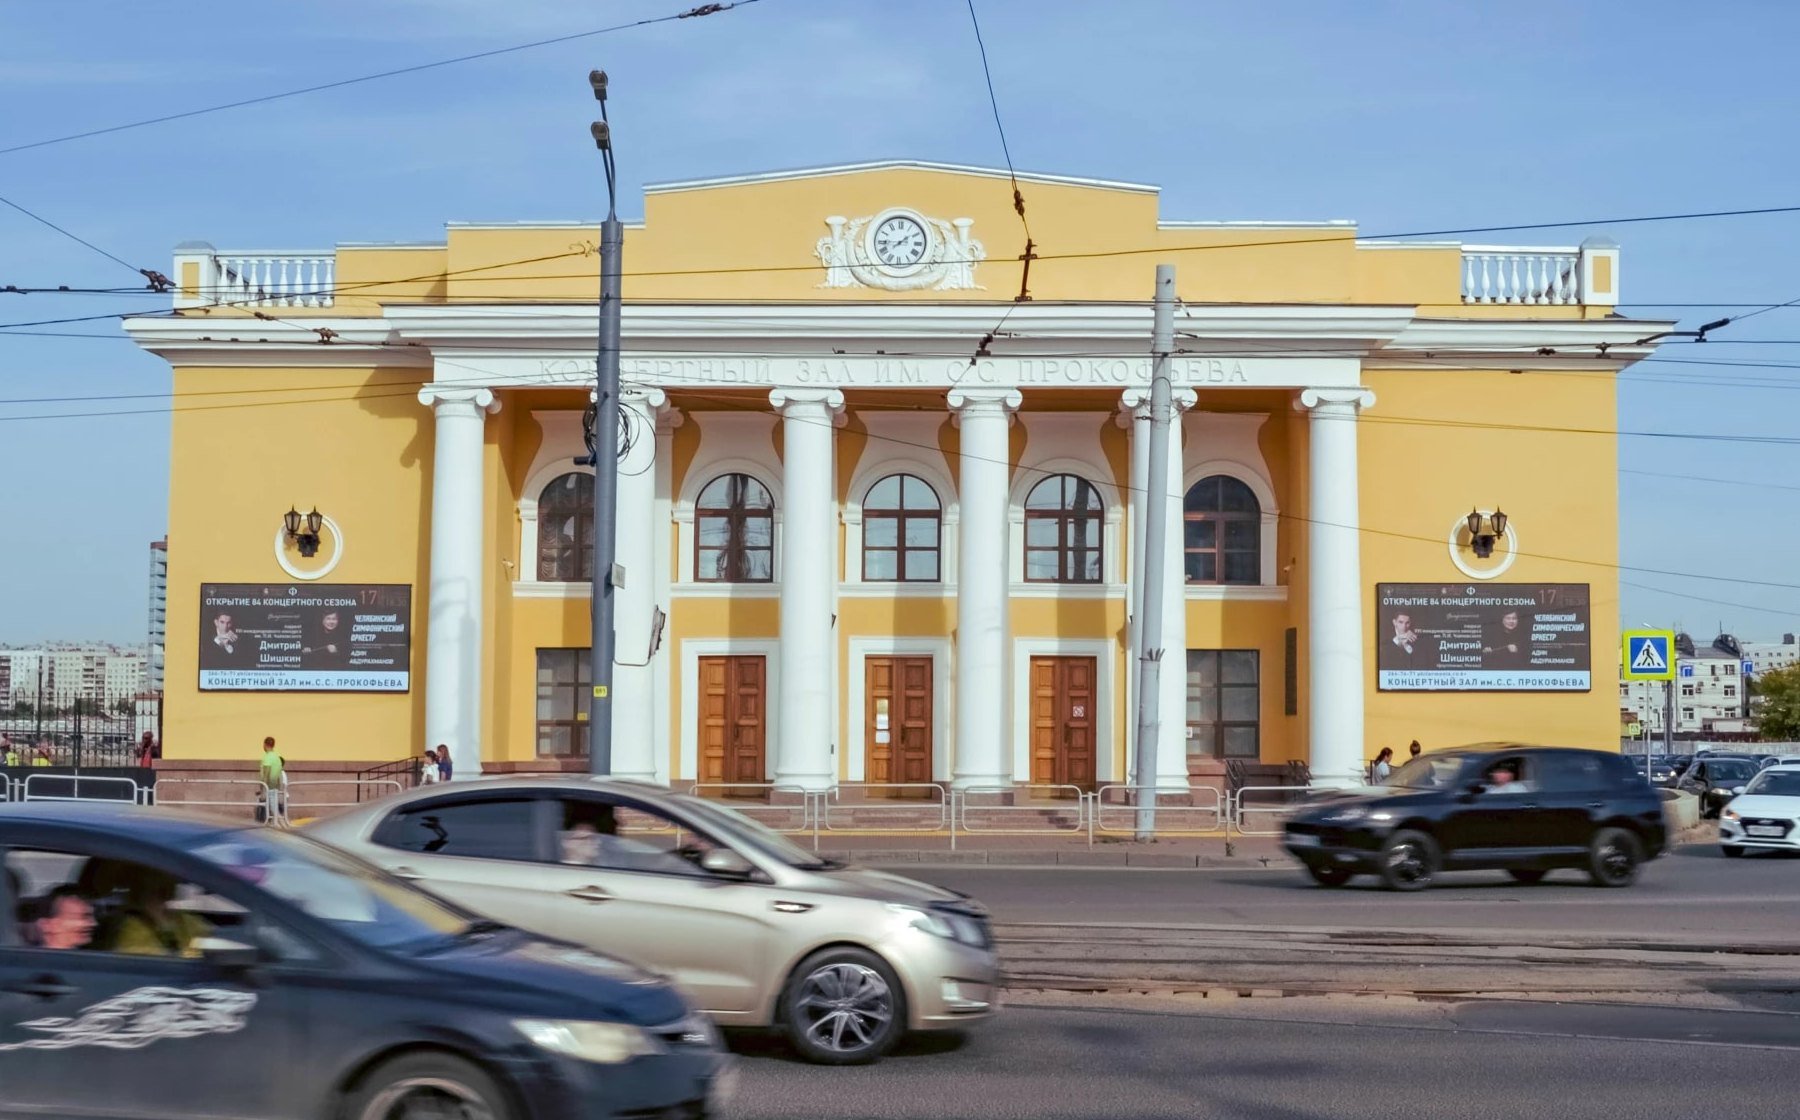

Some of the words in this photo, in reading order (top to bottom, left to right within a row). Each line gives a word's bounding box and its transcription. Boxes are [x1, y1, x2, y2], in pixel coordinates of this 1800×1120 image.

[539, 357, 773, 383] КОНЕРТНЫЙ
[796, 360, 854, 382] ЗАЛ
[874, 360, 929, 382] ИМ.
[360, 590, 377, 605] 17
[1539, 589, 1556, 604] 17
[206, 598, 250, 606] ОТКРЫТИЕ
[252, 598, 261, 606] 84
[263, 598, 322, 607] КОНЦЕРТНОГО
[324, 598, 357, 606] СЕЗОНА
[1383, 598, 1428, 606] ОТКРЫТИЕ
[1430, 598, 1439, 606] 84
[1441, 598, 1501, 606] КОНЦЕРТНОГО
[1503, 598, 1536, 606] СЕЗОНА
[260, 640, 301, 651] Дмитрий
[1439, 640, 1481, 651] Дмитрий
[260, 653, 301, 663] Шишкин
[1440, 653, 1482, 663] Шишкин
[208, 677, 275, 686] КОНЦЕРТНЫЙ
[278, 678, 297, 686] ЗАЛ
[337, 678, 403, 687] ПРОКОФЬЕВА
[1387, 677, 1456, 687] КОНЦЕРТНЫЙ
[1458, 678, 1478, 686] ЗАЛ
[1518, 678, 1585, 687] ПРОКОФЬЕВА
